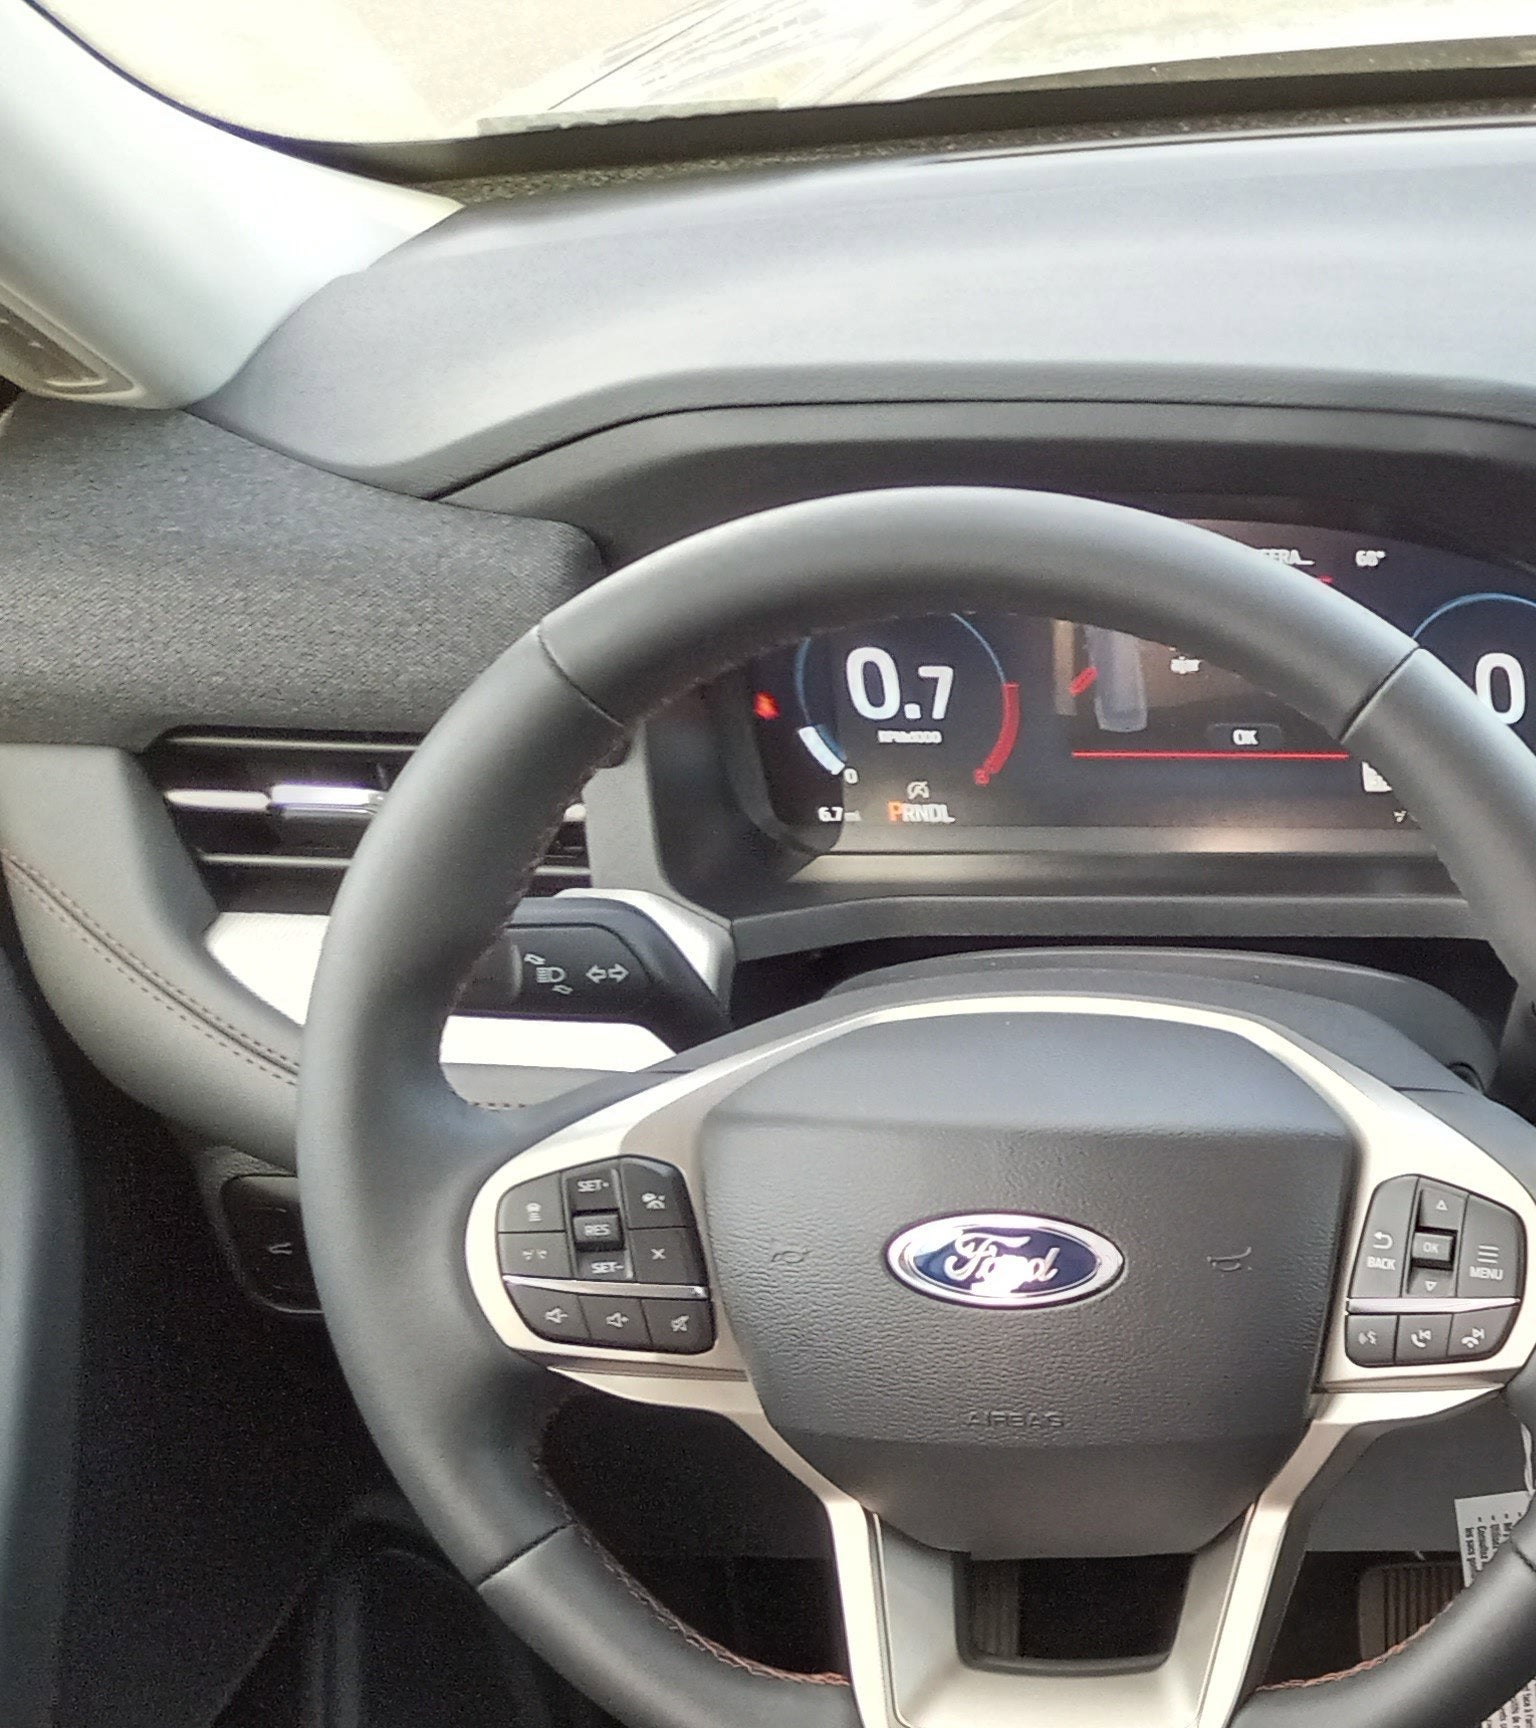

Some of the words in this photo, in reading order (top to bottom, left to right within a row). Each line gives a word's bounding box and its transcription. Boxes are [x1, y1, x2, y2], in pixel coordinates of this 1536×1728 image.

[846, 646, 954, 720] 0.7
[1475, 653, 1526, 725] 0
[1232, 729, 1259, 746] OK
[584, 1223, 611, 1237] RES
[1422, 1241, 1439, 1254] OK
[944, 1230, 1061, 1283] Ford
[1366, 1255, 1397, 1271] BACK
[1468, 1265, 1504, 1281] MENU
